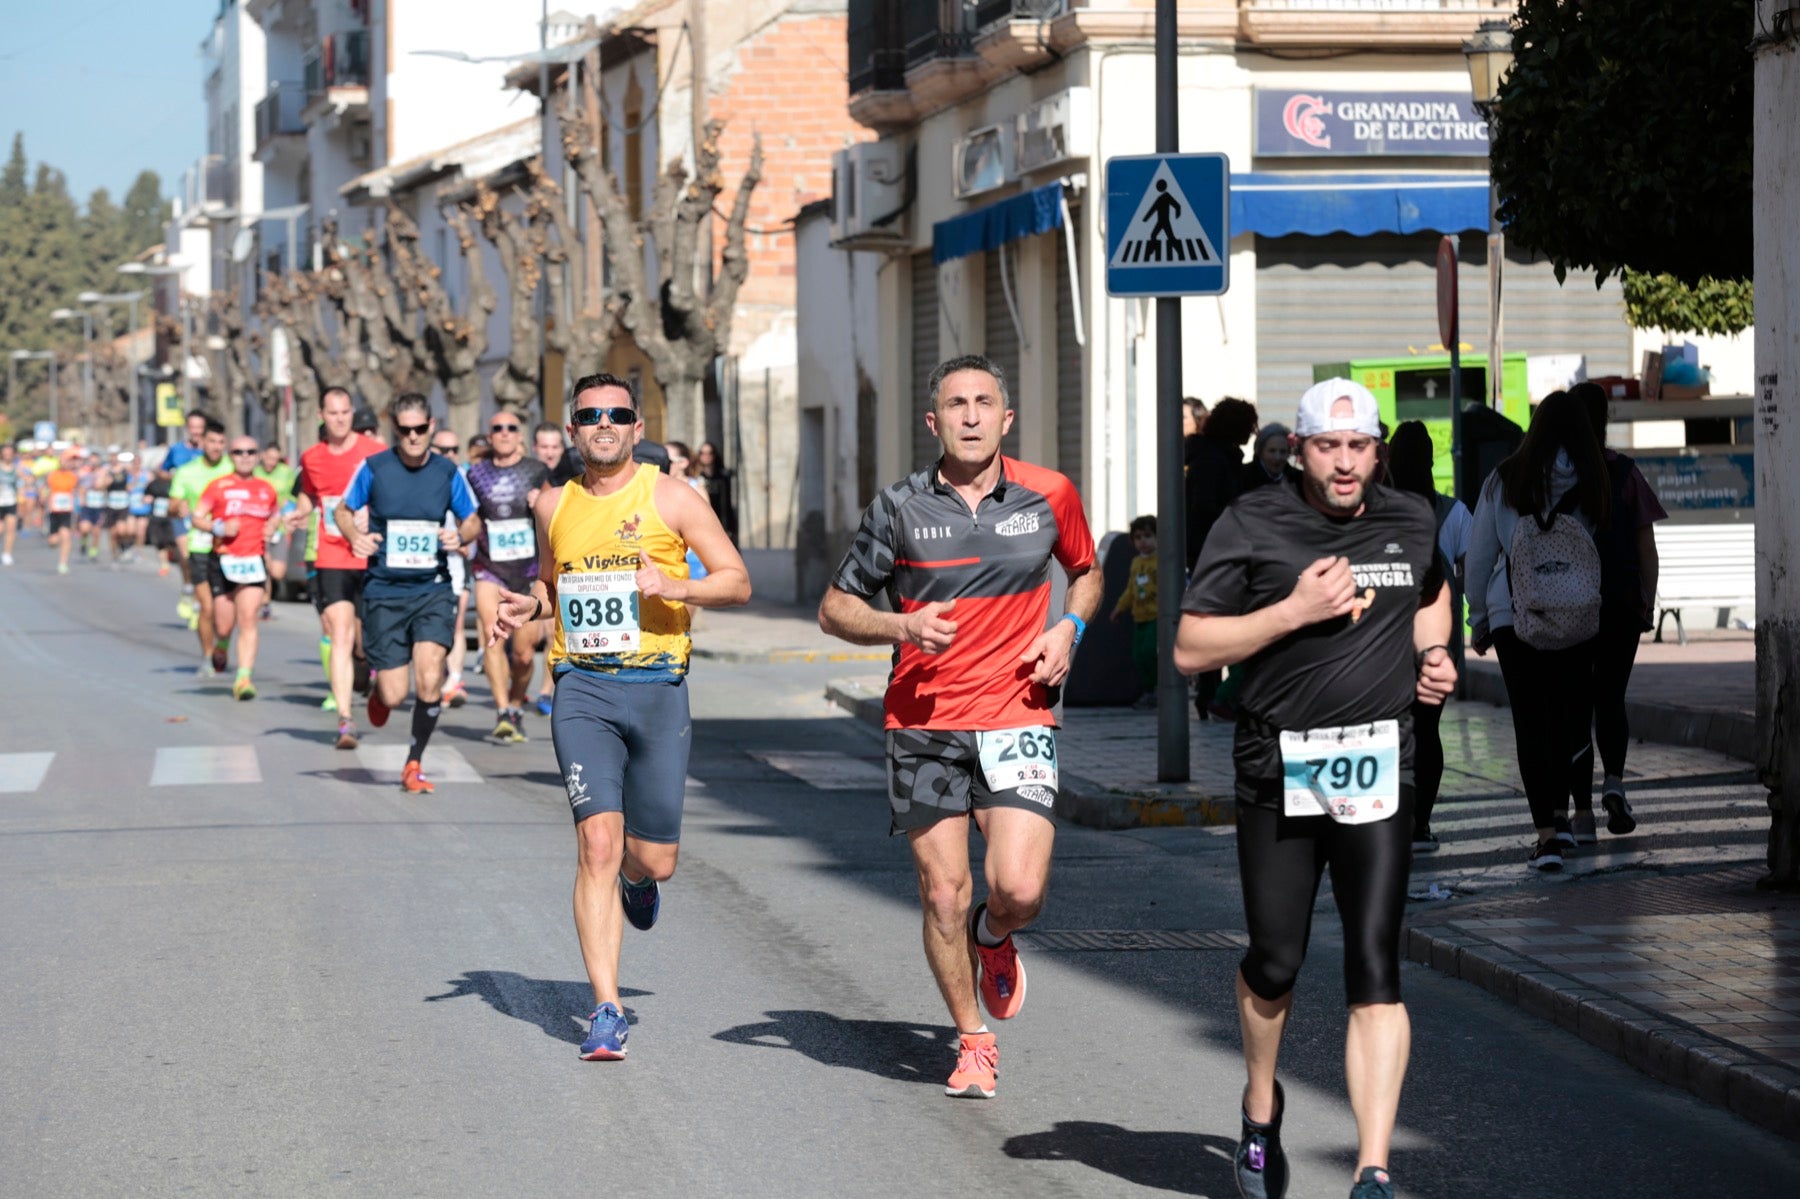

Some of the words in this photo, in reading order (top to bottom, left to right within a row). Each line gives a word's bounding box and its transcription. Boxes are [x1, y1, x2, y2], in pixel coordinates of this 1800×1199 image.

[1337, 102, 1460, 121] GRANADINA
[1353, 121, 1384, 140] DE
[497, 531, 527, 547] 843
[914, 526, 952, 540] GOBIK
[397, 536, 431, 552] 952
[569, 597, 624, 627] 938
[995, 731, 1054, 762] 263
[1306, 756, 1378, 790] 790
